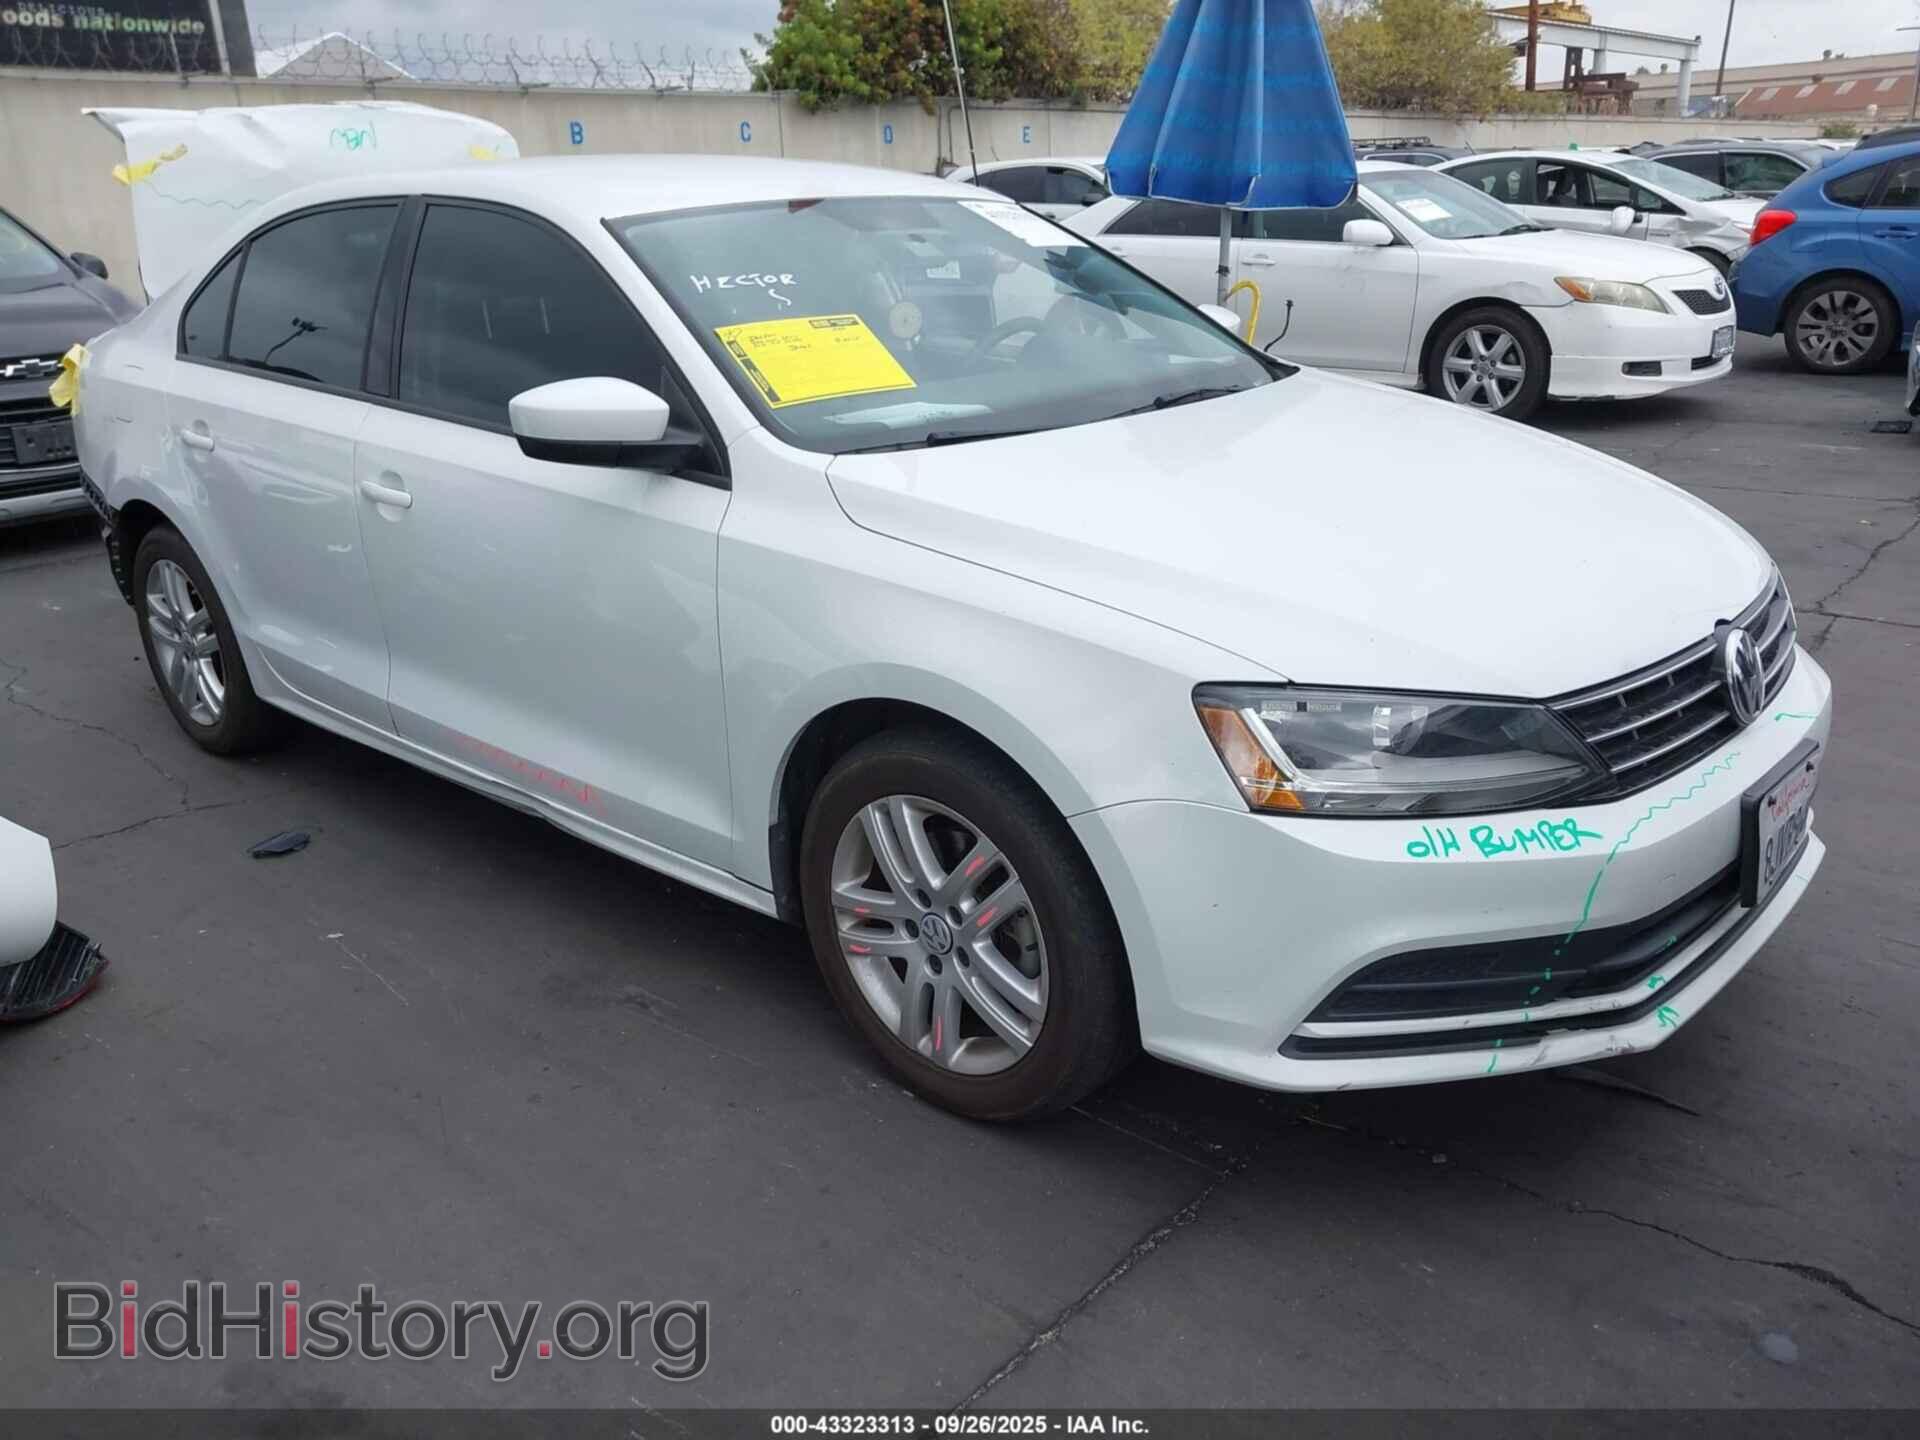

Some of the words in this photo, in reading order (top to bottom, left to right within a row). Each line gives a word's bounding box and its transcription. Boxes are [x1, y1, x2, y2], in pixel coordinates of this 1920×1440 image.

[73, 12, 205, 34] nationwide
[569, 121, 584, 145] B
[740, 122, 752, 143] C
[883, 125, 893, 145] D
[1022, 126, 1031, 144] E
[690, 273, 797, 293] HECTOR
